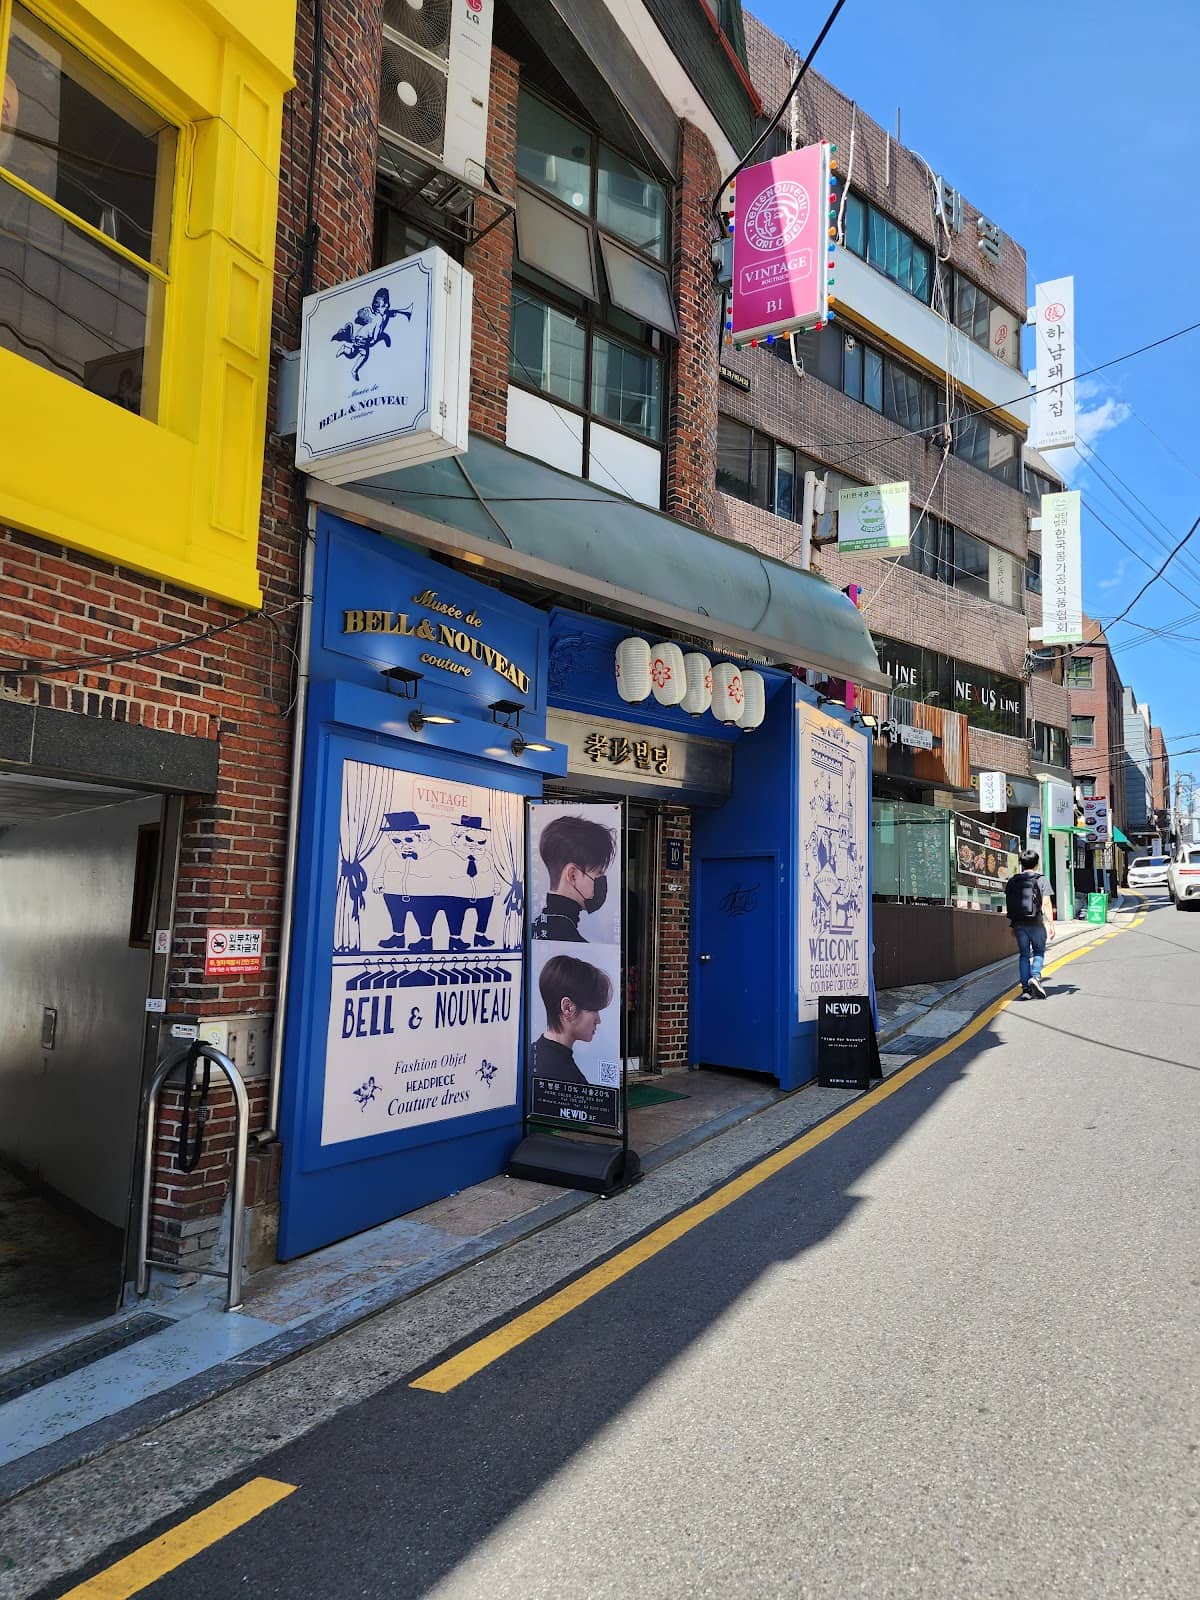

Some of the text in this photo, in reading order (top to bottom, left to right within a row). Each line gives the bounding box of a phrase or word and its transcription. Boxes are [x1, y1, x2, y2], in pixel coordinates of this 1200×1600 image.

[466, 10, 480, 24] LG
[745, 255, 807, 283] VINTAGE
[766, 299, 783, 314] B1
[1046, 324, 1065, 418] 하남돼지집
[319, 395, 408, 430] BELL & NOUVEAU
[412, 590, 483, 628] Musée de
[343, 610, 531, 695] BELL & NOUVEAU
[420, 653, 472, 677] couture
[955, 679, 1020, 714] NEXUS LINE
[417, 787, 468, 807] VINTAGE
[228, 944, 259, 953] 주차금지
[229, 934, 260, 943] 외부차량
[808, 938, 859, 961] WELCOME
[342, 988, 512, 1039] BELL & NOUVEAU
[825, 1003, 861, 1014] NEWID
[394, 1053, 467, 1075] Fashion Objet
[406, 1074, 456, 1093] HEADPIECE
[564, 1085, 578, 1093] 10%
[387, 1089, 470, 1116] Couture dress
[560, 1108, 587, 1120] NEWID
